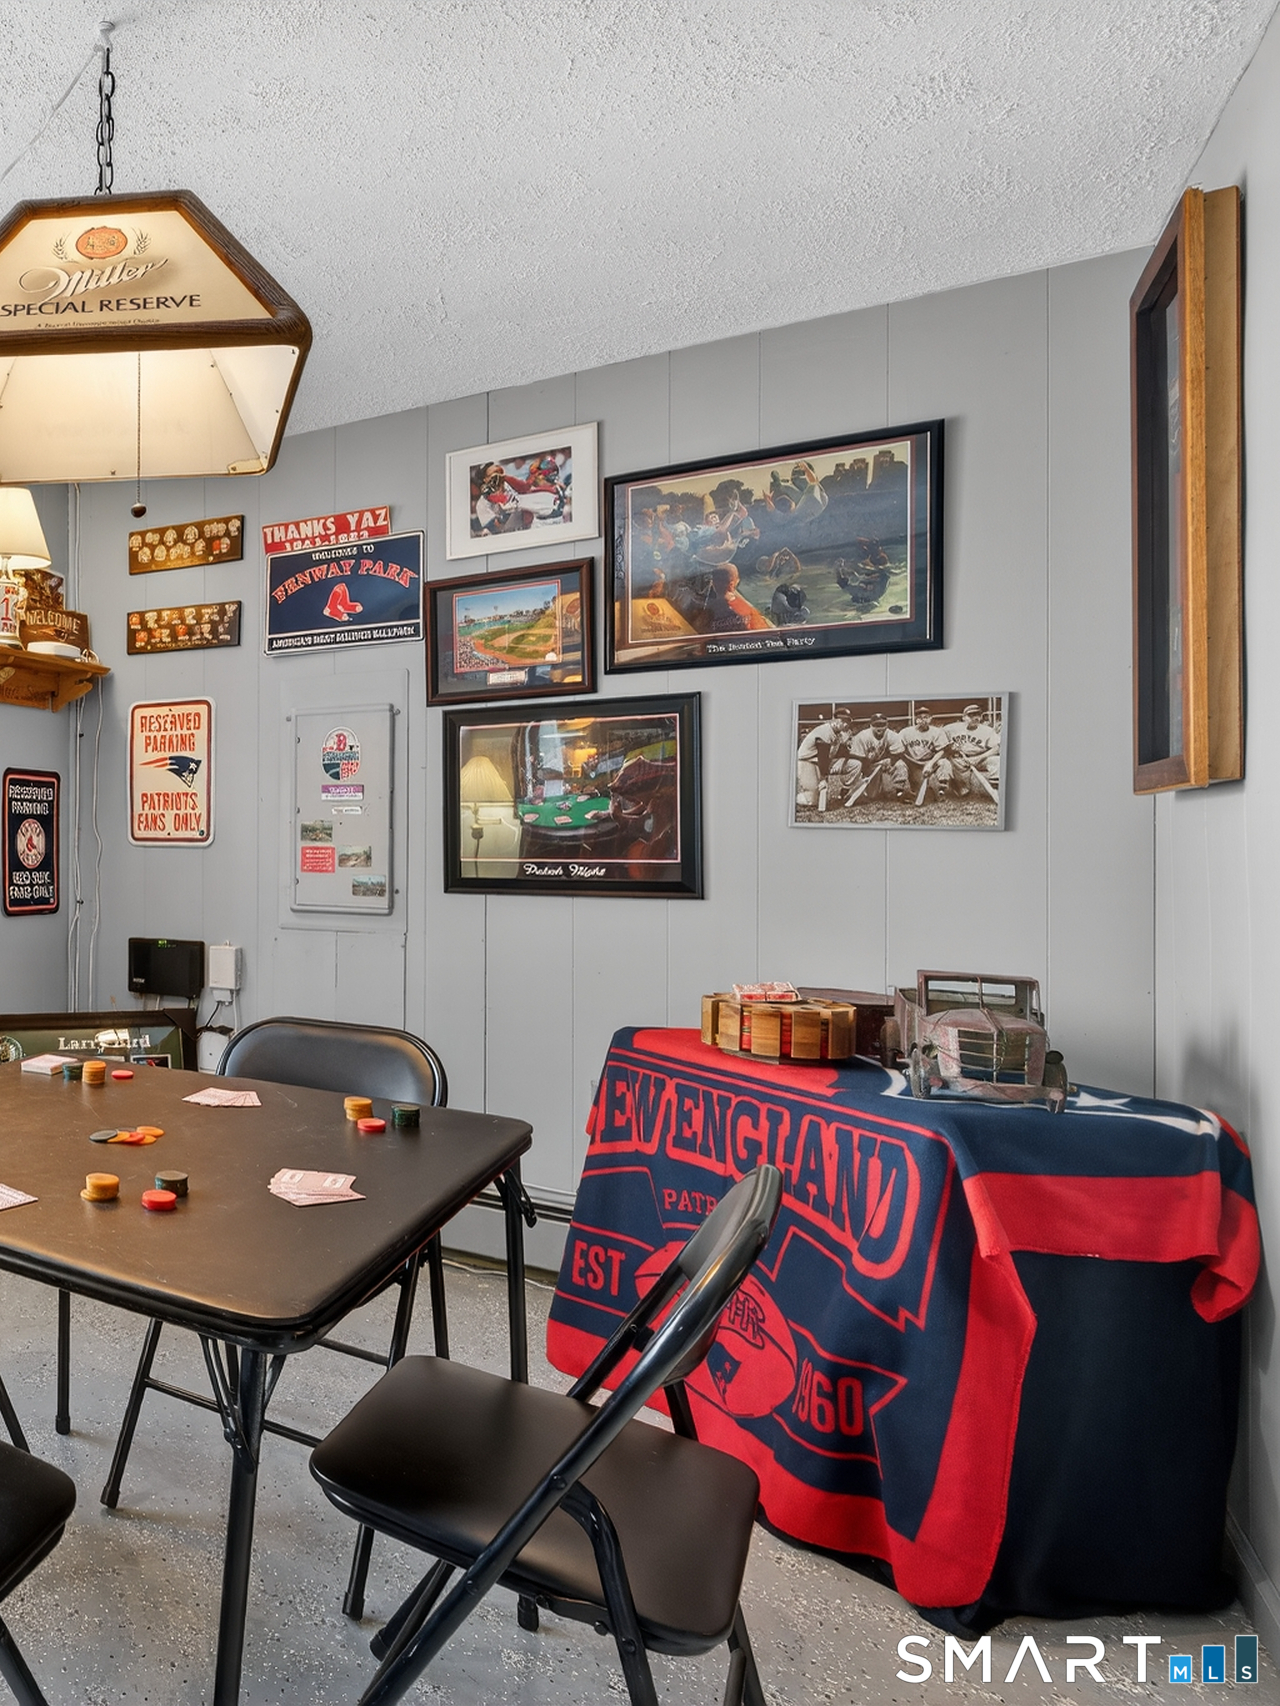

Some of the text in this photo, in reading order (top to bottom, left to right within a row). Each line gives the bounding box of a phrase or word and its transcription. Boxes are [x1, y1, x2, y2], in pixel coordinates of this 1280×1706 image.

[19, 256, 168, 303] Miller
[0, 294, 202, 317] SPECIAL RESERVE
[263, 508, 388, 544] THANKS YAZ
[362, 544, 375, 554] TO
[271, 560, 419, 604] FENWAY PARK
[26, 609, 81, 634] WELCOME
[140, 712, 202, 733] RESERVED
[144, 733, 196, 753] PARKING
[141, 791, 198, 811] PATRIOTS
[137, 812, 202, 832] FANS ONLY
[588, 1062, 920, 1280] EW ENGLAND
[662, 1188, 719, 1216] PATR
[572, 1240, 626, 1296] EST
[792, 1357, 864, 1437] 1960
